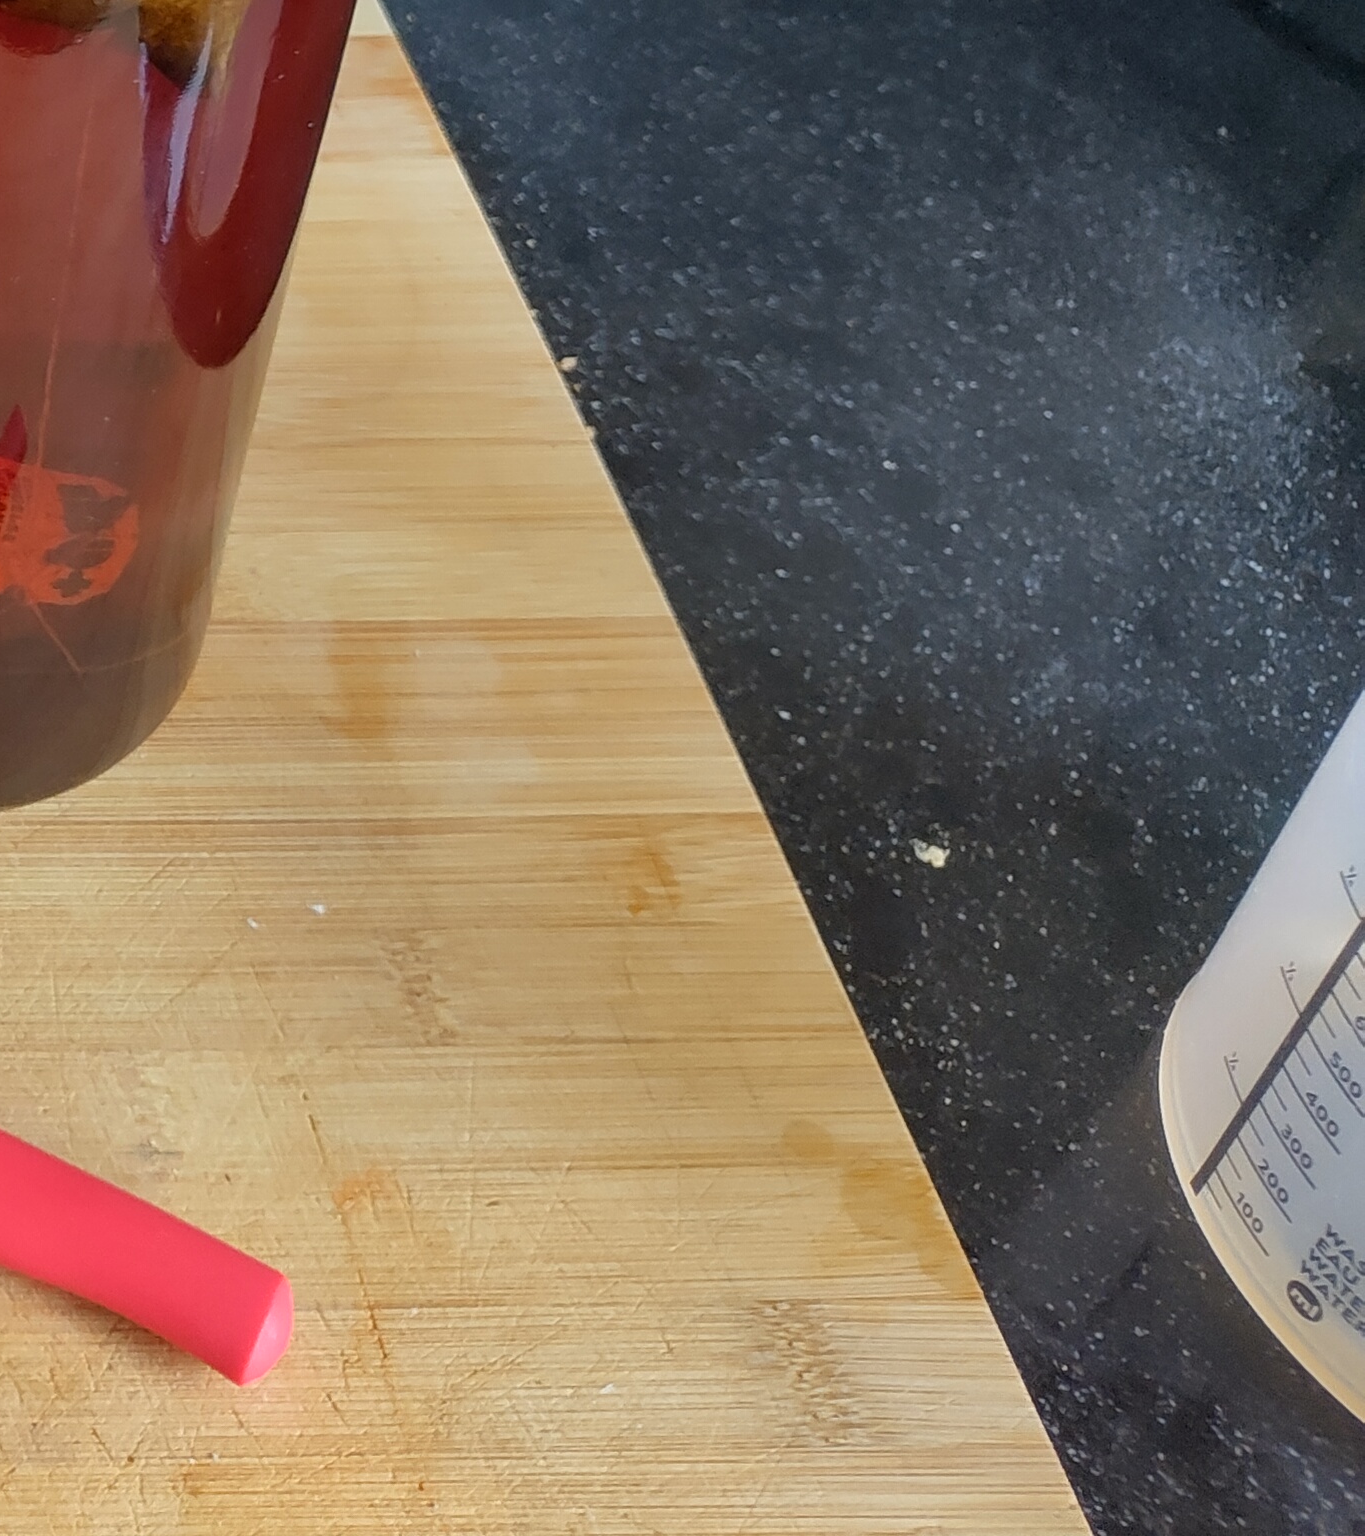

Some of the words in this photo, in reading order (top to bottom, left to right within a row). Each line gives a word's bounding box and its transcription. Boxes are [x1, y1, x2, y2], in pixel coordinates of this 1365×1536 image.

[1329, 1050, 1363, 1099] 500
[1305, 1091, 1340, 1138] 400
[1281, 1123, 1314, 1170] 300
[1257, 1158, 1289, 1205] 200
[1236, 1191, 1264, 1234] 100
[1310, 1247, 1365, 1316] WATE
[1315, 1236, 1361, 1286] EAU
